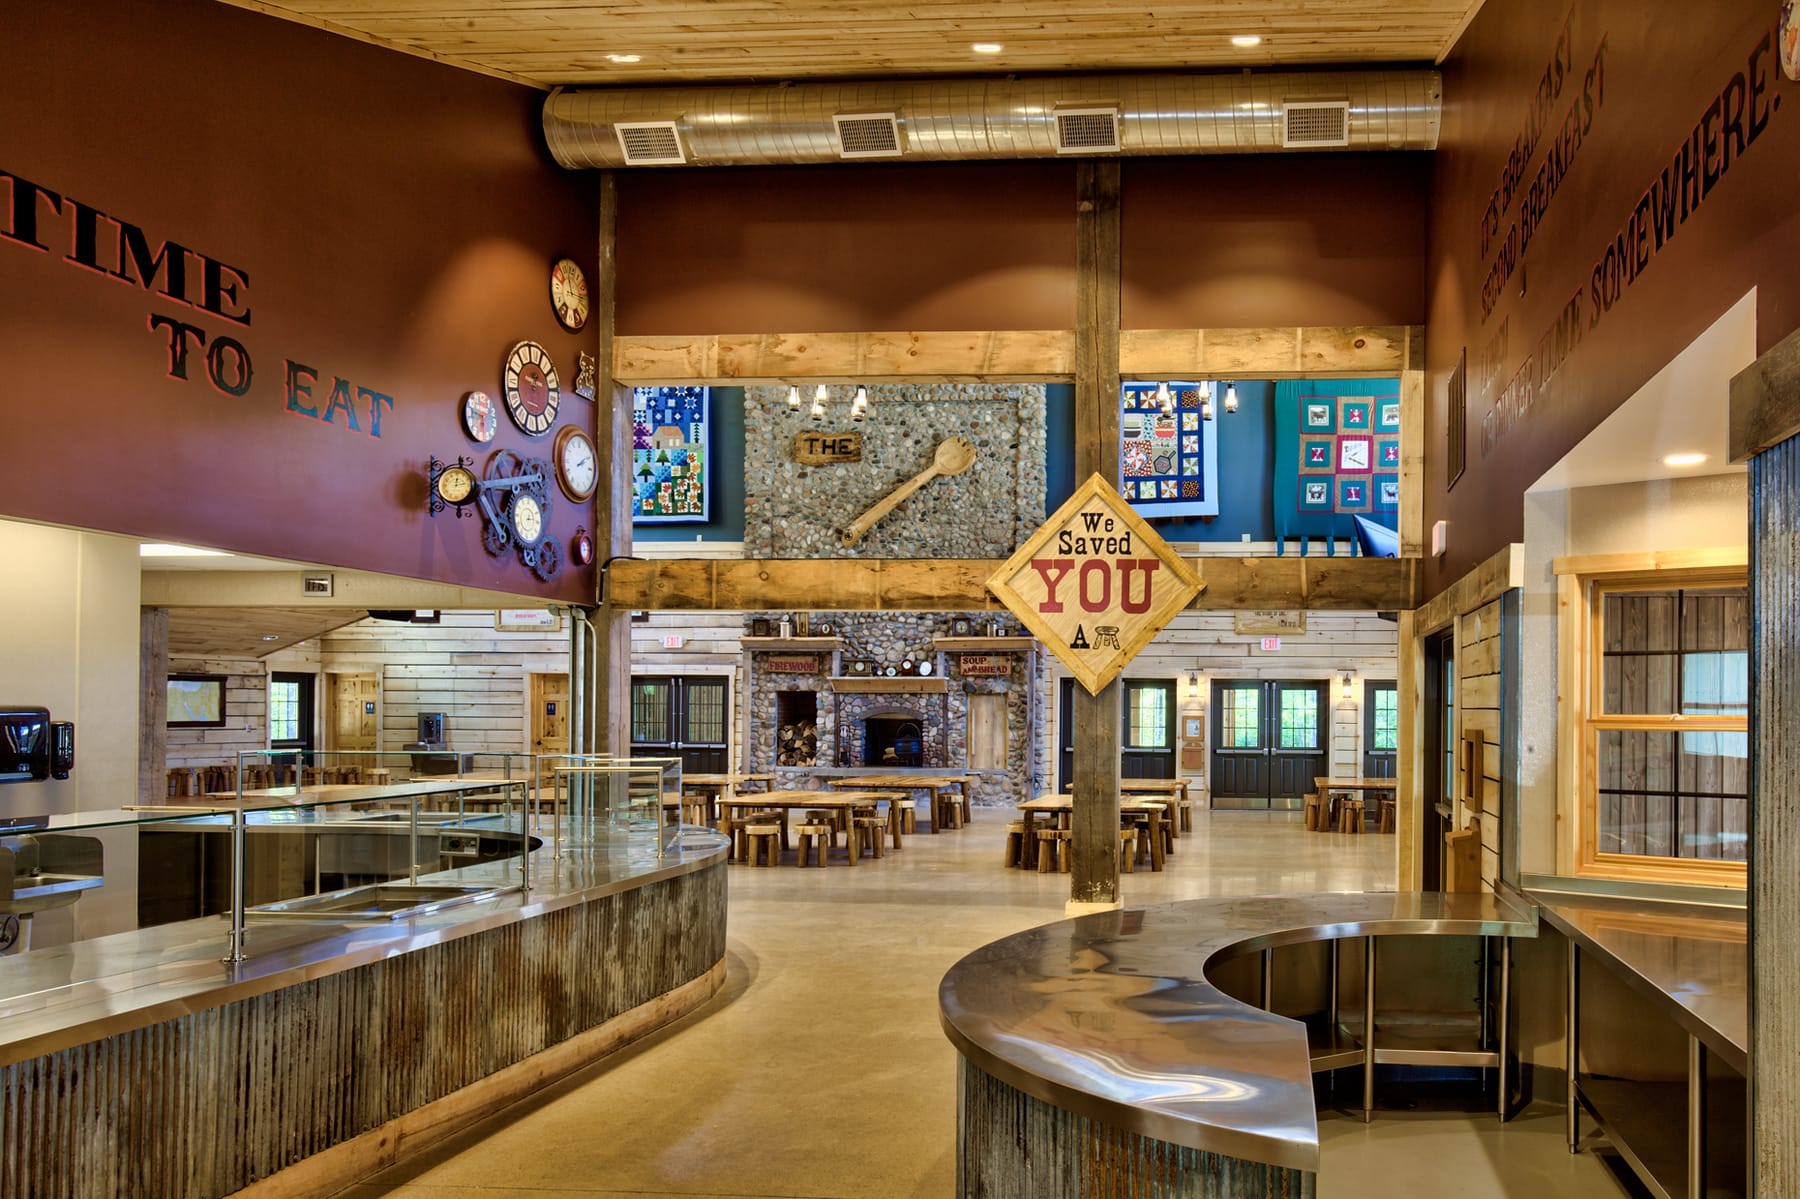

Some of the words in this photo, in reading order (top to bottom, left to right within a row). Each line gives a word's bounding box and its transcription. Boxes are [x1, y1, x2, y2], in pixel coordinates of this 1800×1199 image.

[1502, 3, 1576, 217] BREAKFAST
[1481, 223, 1516, 327] SECOND
[1519, 31, 1609, 258] BREAKFAST
[0, 169, 251, 328] TIME
[146, 312, 255, 397] TO
[282, 358, 394, 440] EAT
[804, 438, 853, 455] THE
[1081, 512, 1114, 533] We
[1058, 530, 1132, 555] Saved
[1031, 559, 1160, 614] YOU
[1070, 624, 1090, 649] A
[1263, 638, 1278, 649] EXIT
[769, 661, 815, 672] FIREWOOD
[962, 656, 987, 665] SOUP
[979, 665, 1008, 674] BREAD
